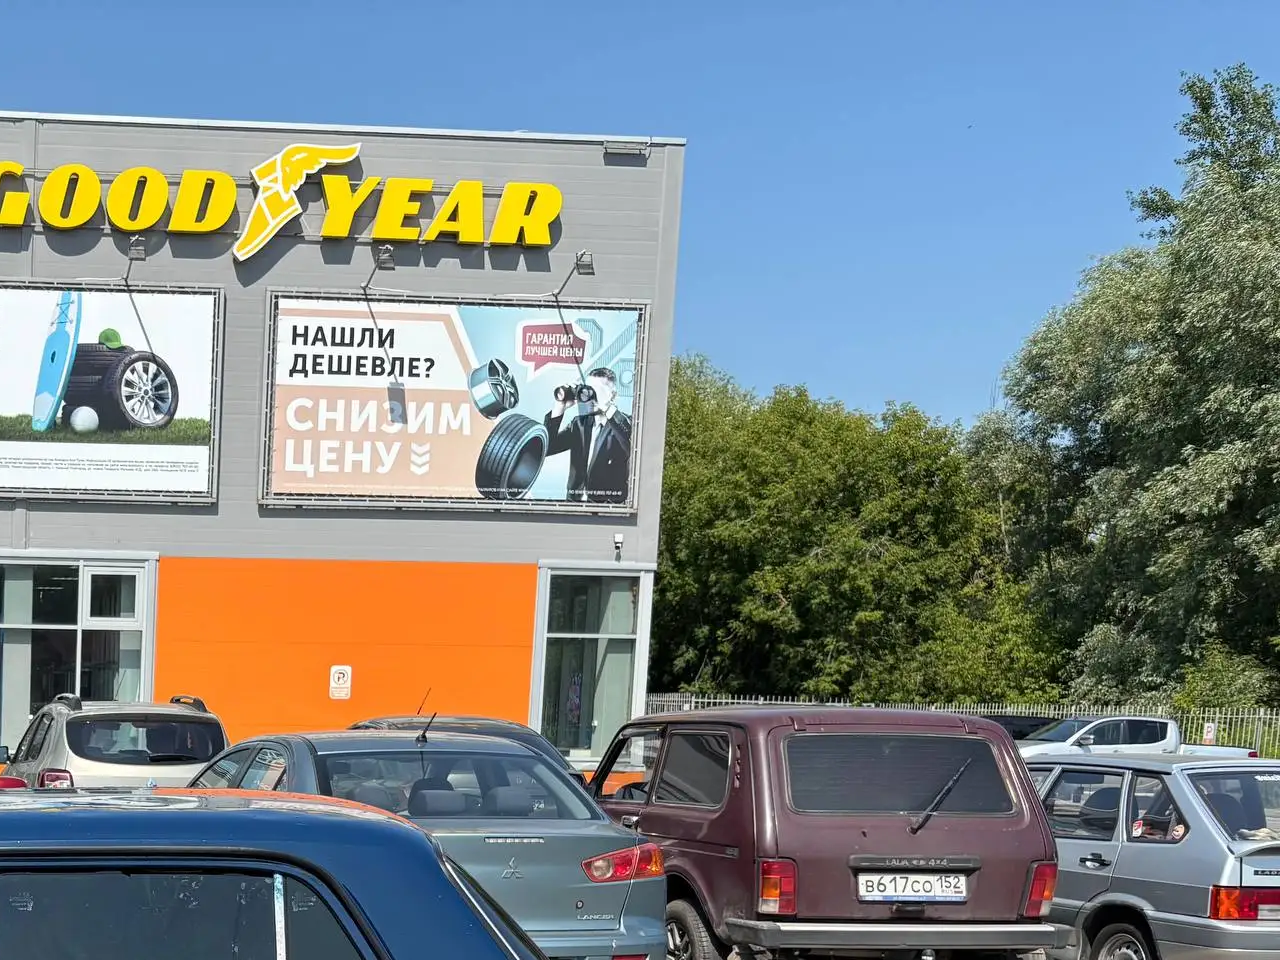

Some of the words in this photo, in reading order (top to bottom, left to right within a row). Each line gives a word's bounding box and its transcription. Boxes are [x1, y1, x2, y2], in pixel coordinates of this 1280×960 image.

[291, 325, 395, 349] НАШЛИ
[525, 332, 574, 345] ГАРАНТИЯ
[524, 345, 558, 357] ЛУЧШЕЙ
[288, 353, 436, 379] ДЕШЕВЛЕ?
[285, 397, 472, 436] СНИЗИМ
[284, 439, 403, 478] ЦЕНУ
[936, 875, 961, 889] 152
